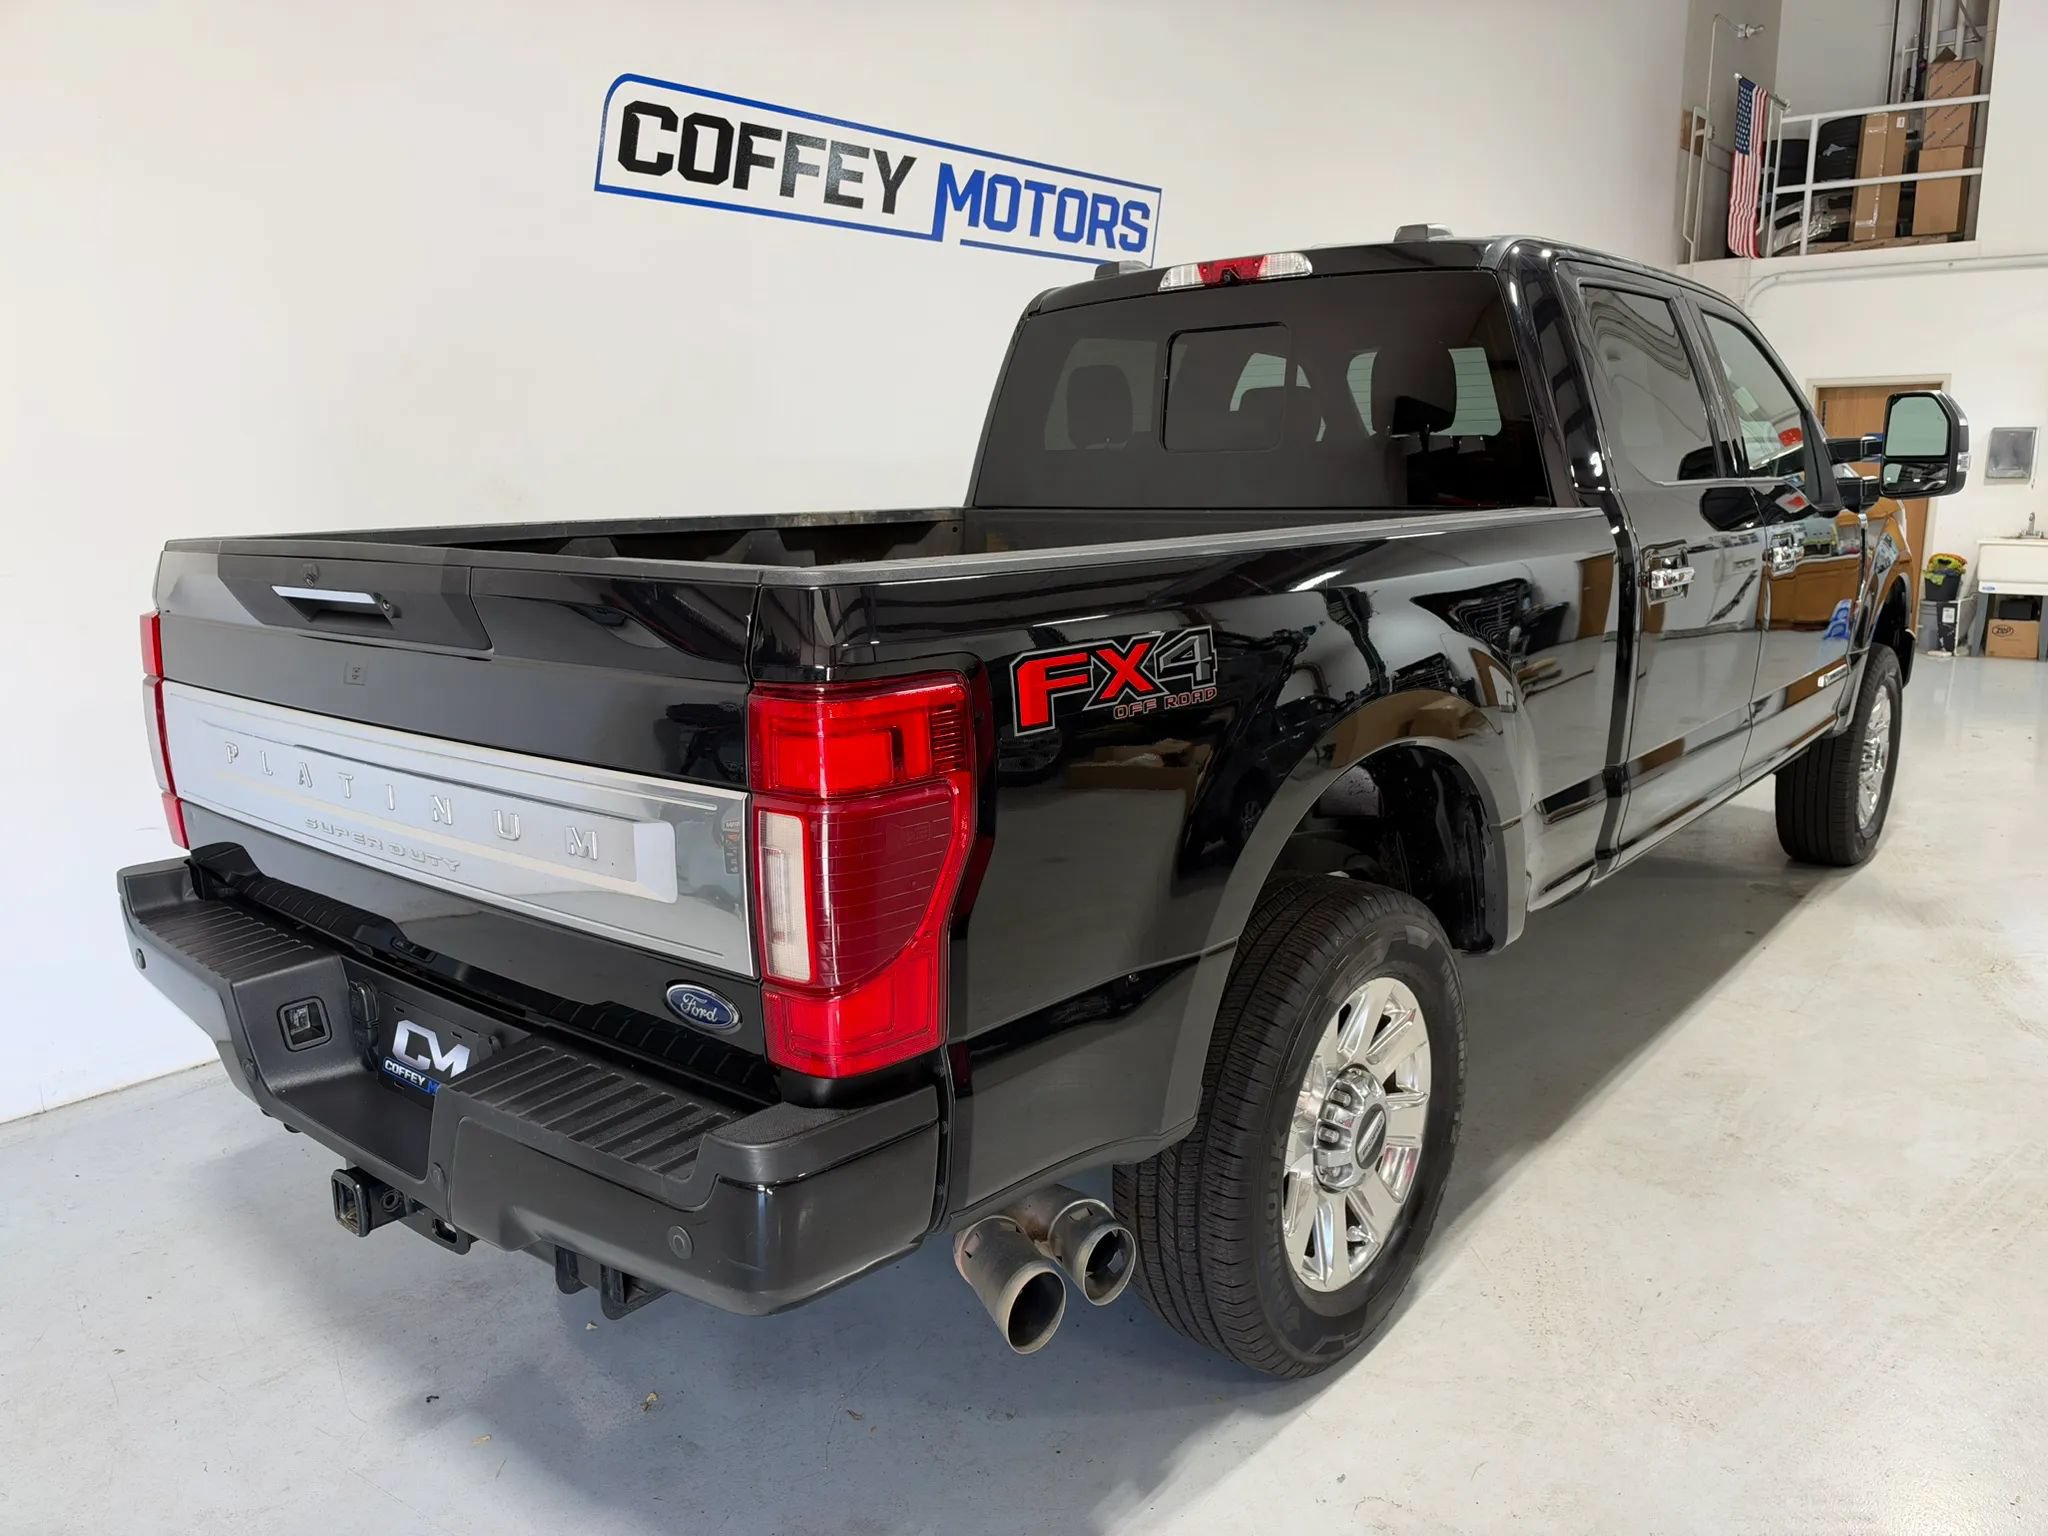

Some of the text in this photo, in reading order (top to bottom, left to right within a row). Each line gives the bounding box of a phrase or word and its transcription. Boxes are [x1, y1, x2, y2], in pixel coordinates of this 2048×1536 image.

[617, 100, 1150, 252] COFFEY MOTORS
[1010, 626, 1217, 736] FX4
[1113, 687, 1217, 720] OFF ROAD
[225, 742, 599, 860] PLATINUM
[305, 816, 460, 872] SUPER DUTY
[680, 993, 718, 1023] Ford
[385, 1060, 426, 1086] COFFEY
[392, 1020, 470, 1078] CM
